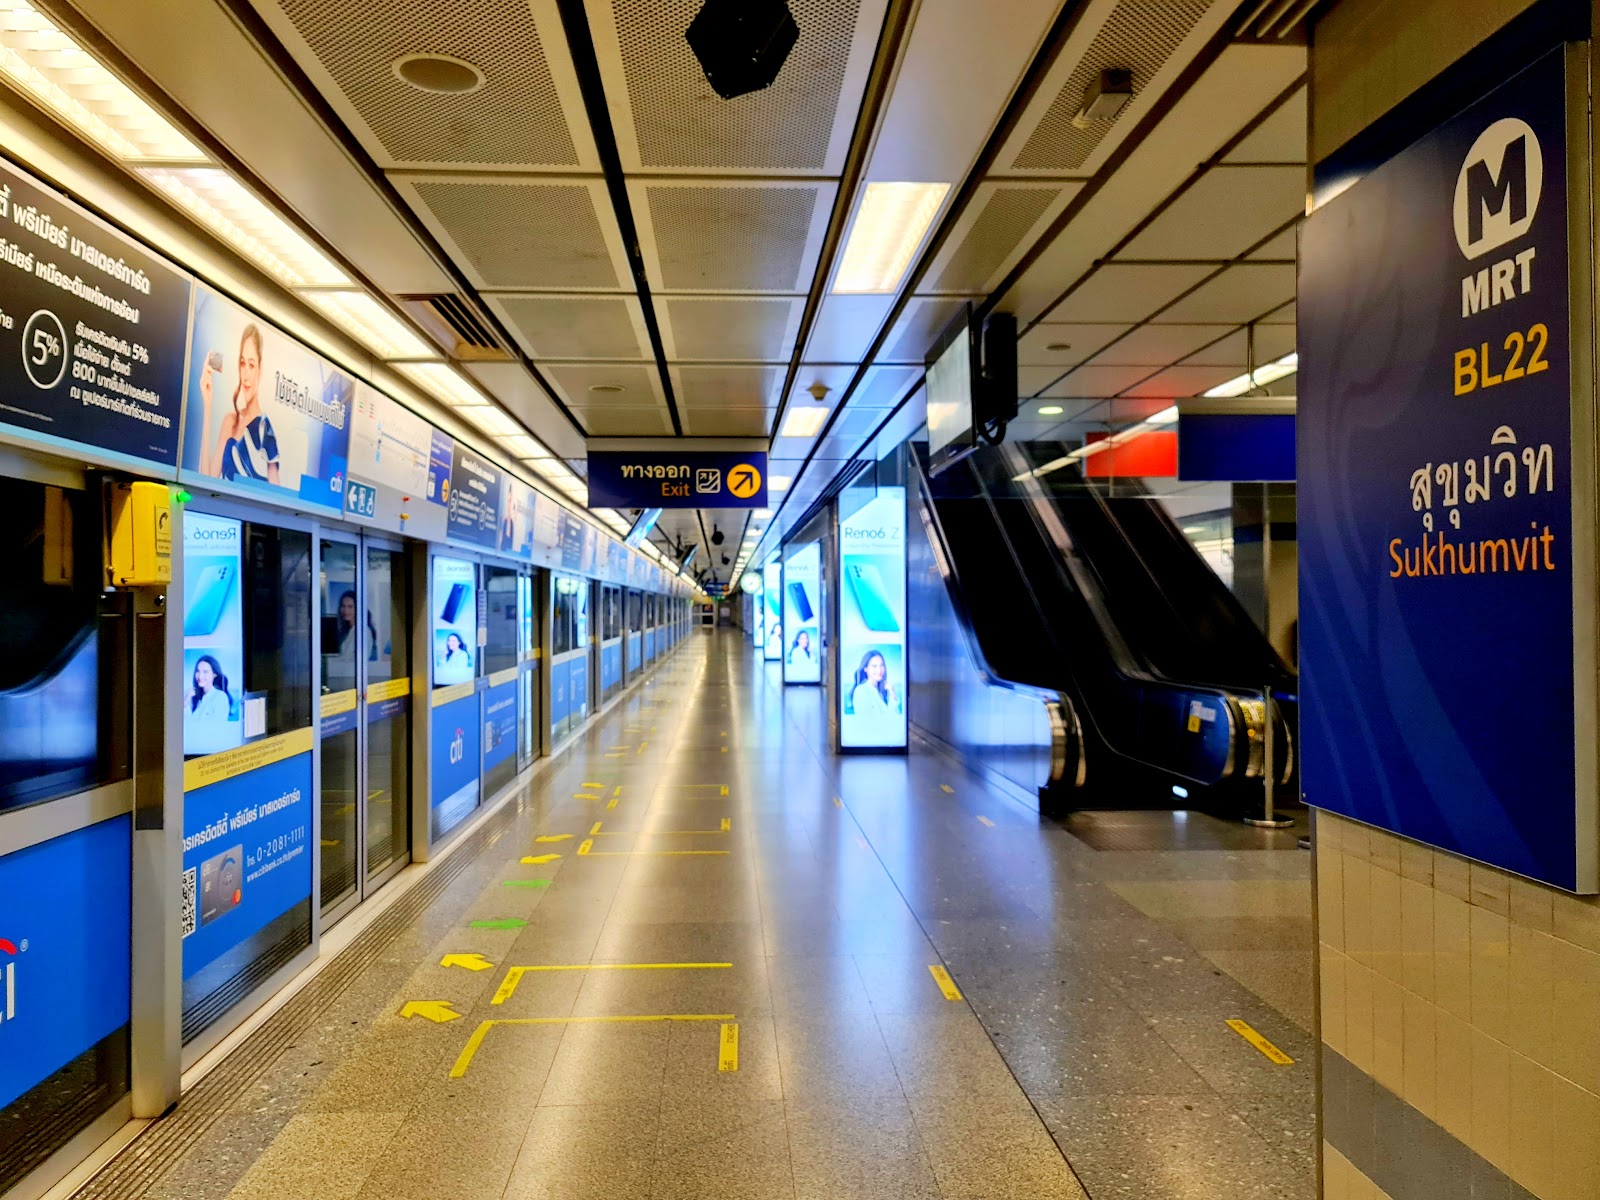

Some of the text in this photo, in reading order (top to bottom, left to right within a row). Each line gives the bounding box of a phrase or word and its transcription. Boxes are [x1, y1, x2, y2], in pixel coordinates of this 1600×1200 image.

[13, 203, 69, 249] พรีเมียร์
[1462, 247, 1536, 319] MRT
[32, 329, 60, 366] 5%
[132, 343, 149, 364] 5%
[1454, 323, 1549, 396] BL22
[72, 361, 96, 383] 800
[621, 465, 690, 479] ทางออก
[661, 482, 691, 497] Exit
[1409, 425, 1554, 532] สุขุมวิท
[845, 526, 885, 539] Reno6
[1389, 522, 1555, 578] Sukhumvit
[257, 825, 305, 862] 0-2081-1111
